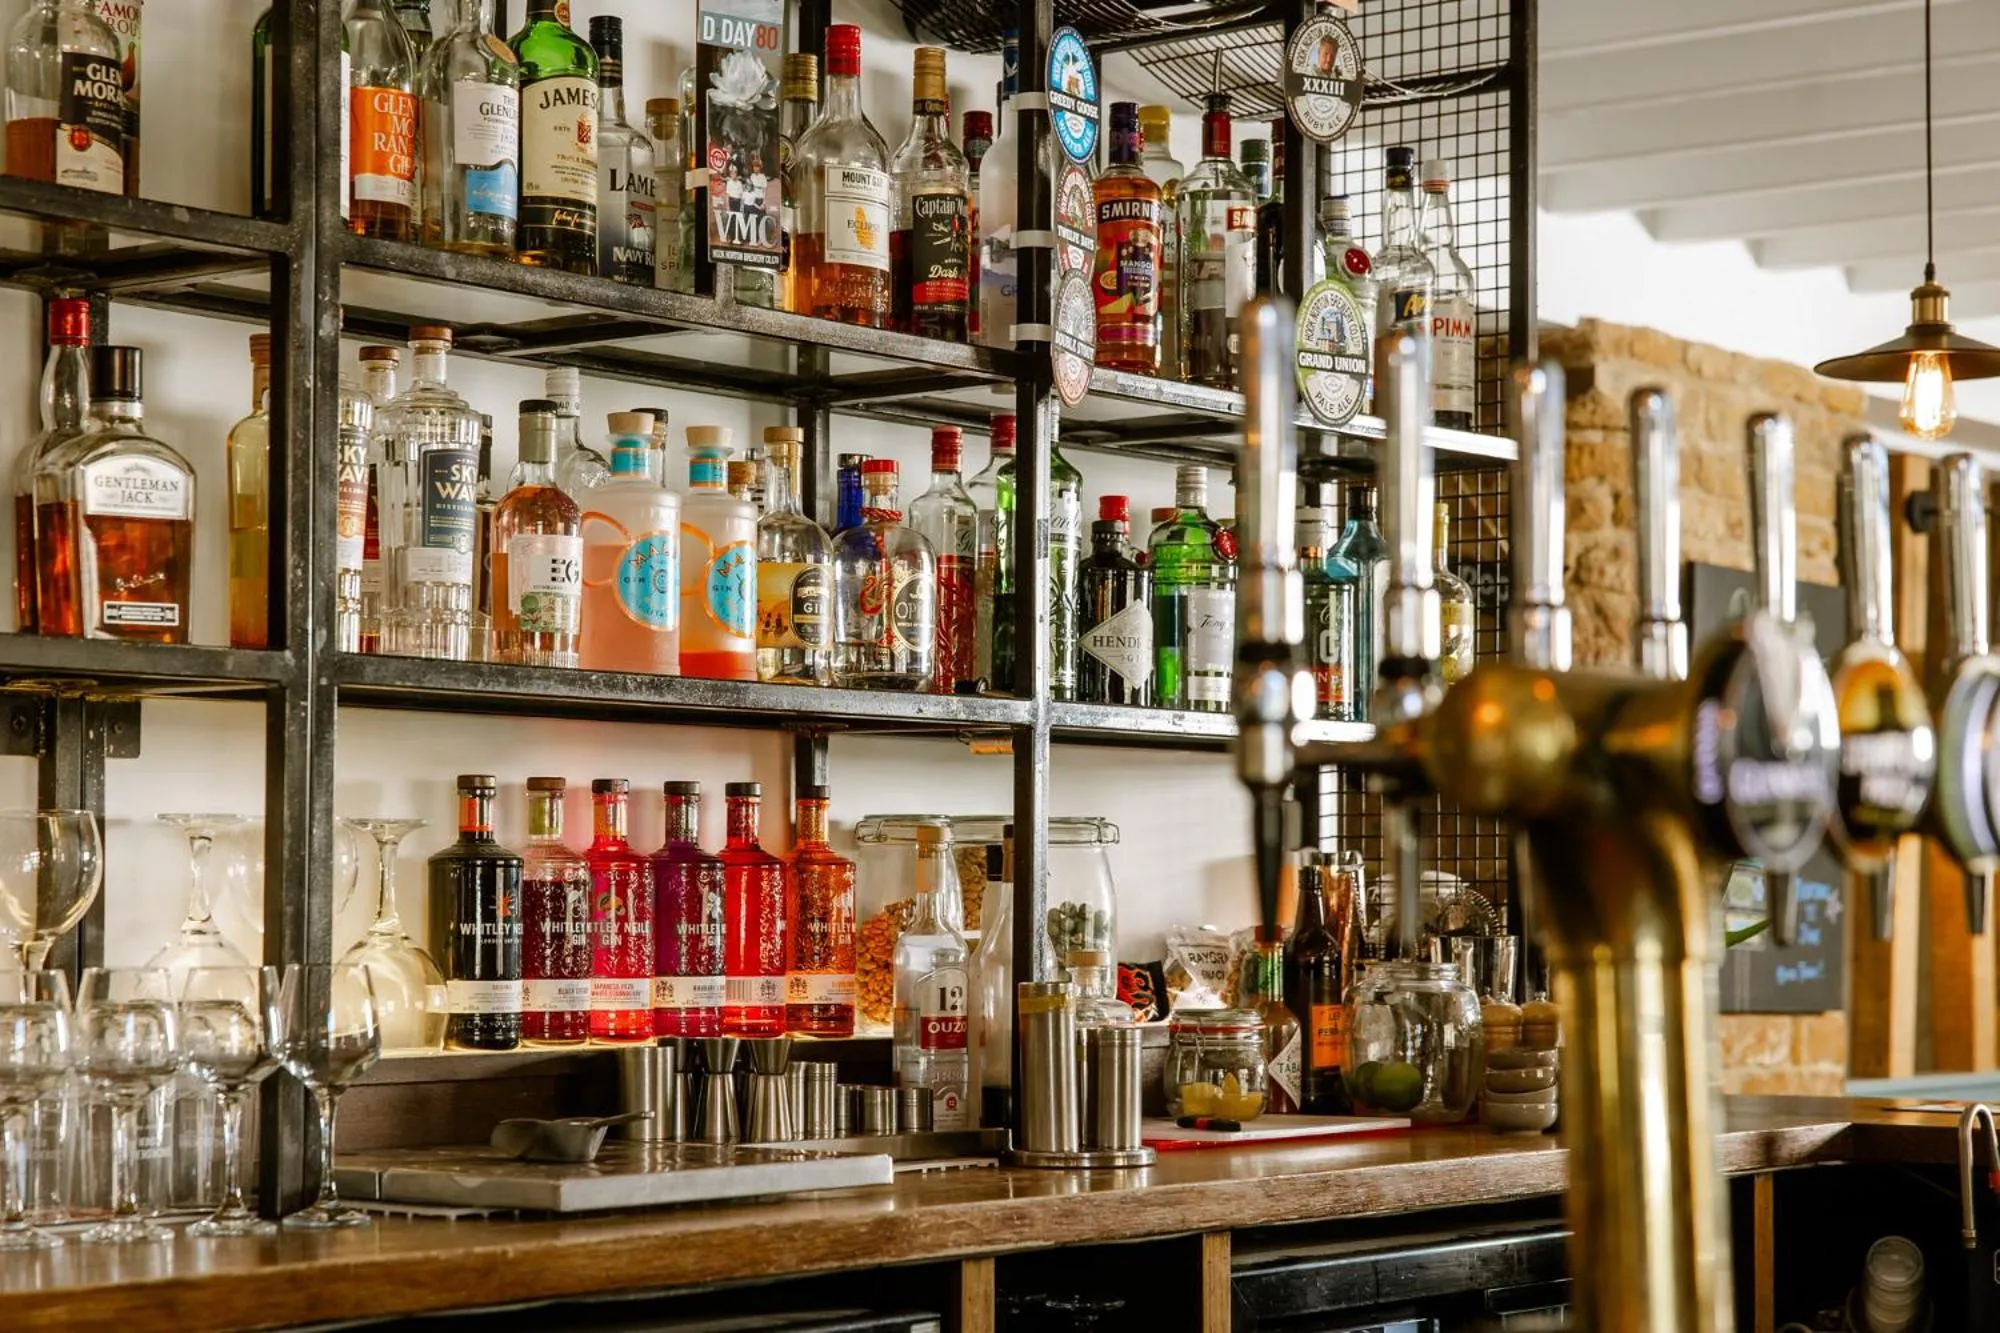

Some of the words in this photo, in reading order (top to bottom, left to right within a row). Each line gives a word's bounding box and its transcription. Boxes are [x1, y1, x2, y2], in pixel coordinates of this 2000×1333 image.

[756, 24, 779, 51] 80
[86, 63, 122, 86] GLEN
[1302, 77, 1345, 96] XXXIII
[373, 92, 414, 118] GLEN
[539, 87, 597, 110] JAMES
[1303, 112, 1325, 130] RUBY
[1327, 115, 1342, 129] ALE
[373, 131, 409, 156] RAN
[842, 171, 870, 185] MOUNT
[915, 196, 956, 218] Captain
[713, 210, 779, 249] VMC
[928, 264, 958, 279] Dark
[1299, 351, 1333, 371] GRAND
[1333, 355, 1366, 375] UNION
[1314, 391, 1336, 414] PALE
[1337, 393, 1353, 414] ALE
[93, 474, 179, 492] GENTLEMAN
[120, 489, 155, 504] JACK
[623, 575, 647, 584] GIN
[712, 584, 733, 593] GIN
[460, 922, 511, 936] WHITLEY
[602, 933, 622, 947] GIN
[938, 985, 964, 1012] 12
